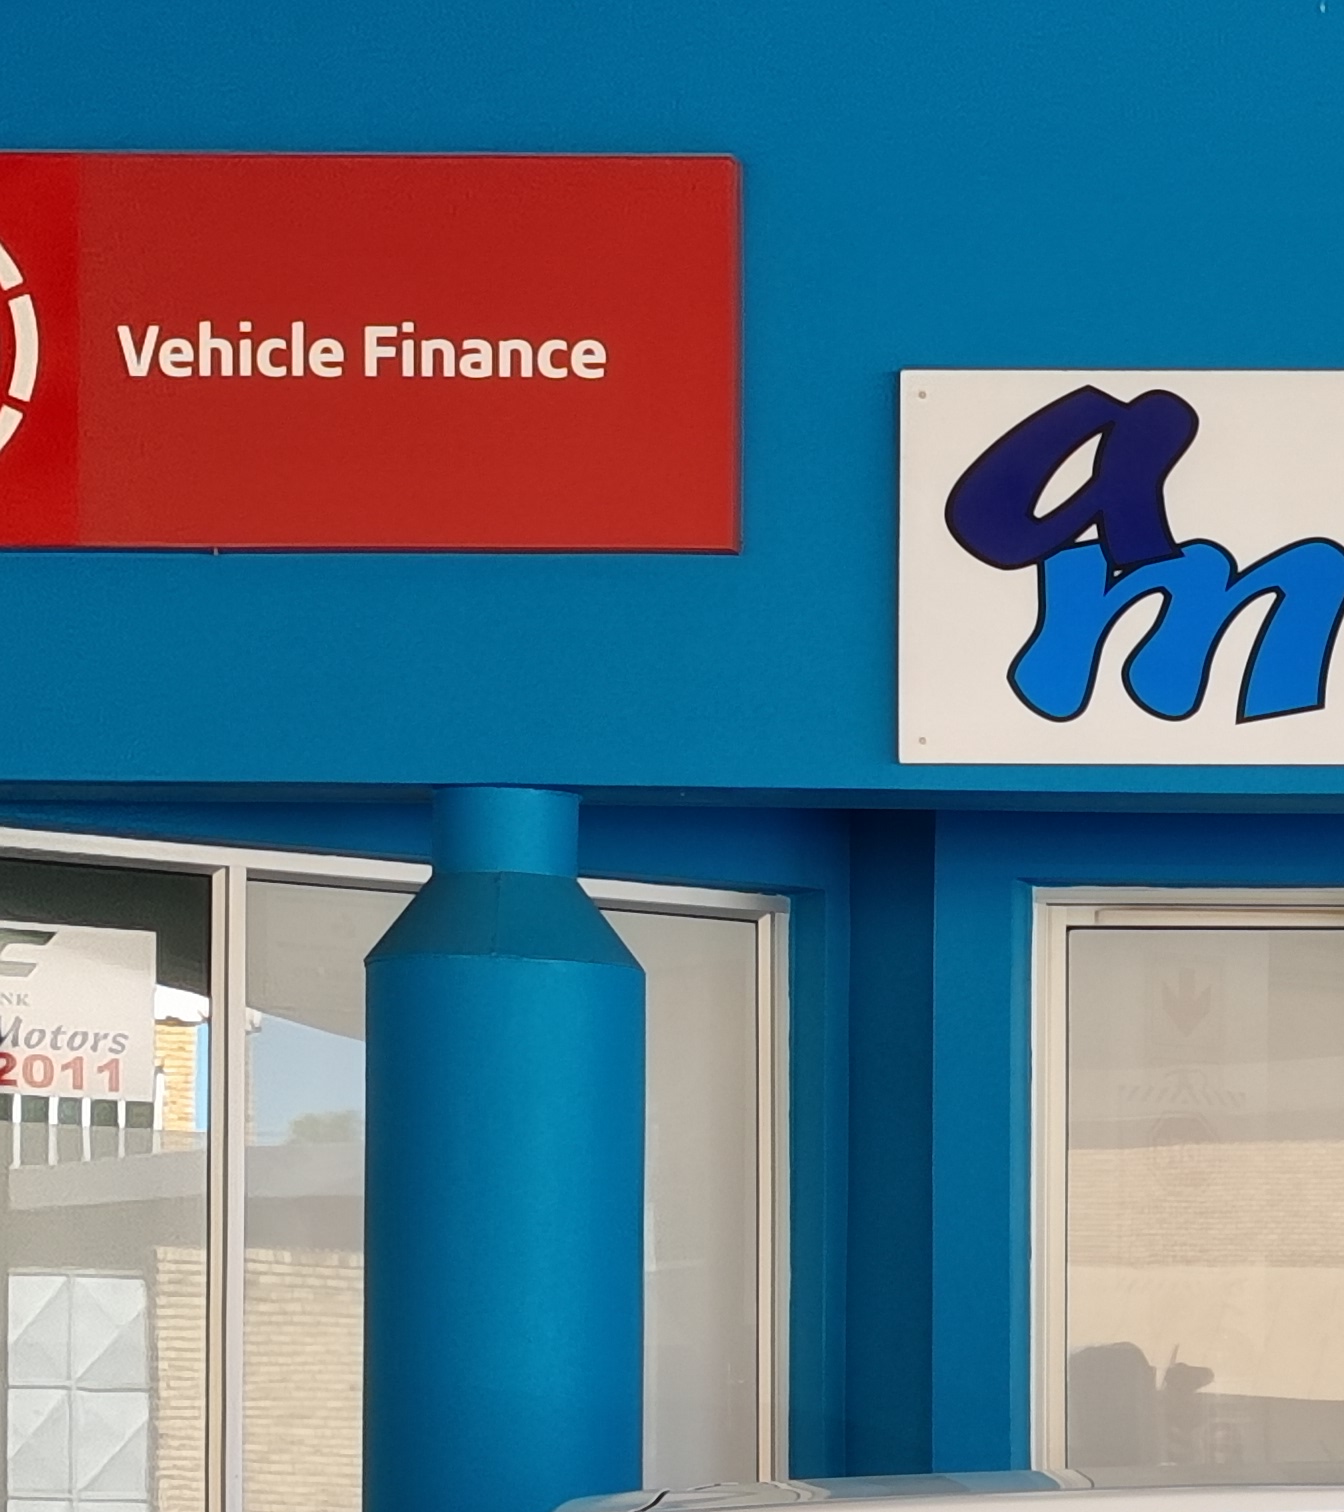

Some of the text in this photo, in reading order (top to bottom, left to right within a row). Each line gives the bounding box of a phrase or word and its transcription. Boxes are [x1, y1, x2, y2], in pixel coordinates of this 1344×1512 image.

[117, 320, 607, 379] Vehicle Finance
[0, 1051, 120, 1093] 2011
